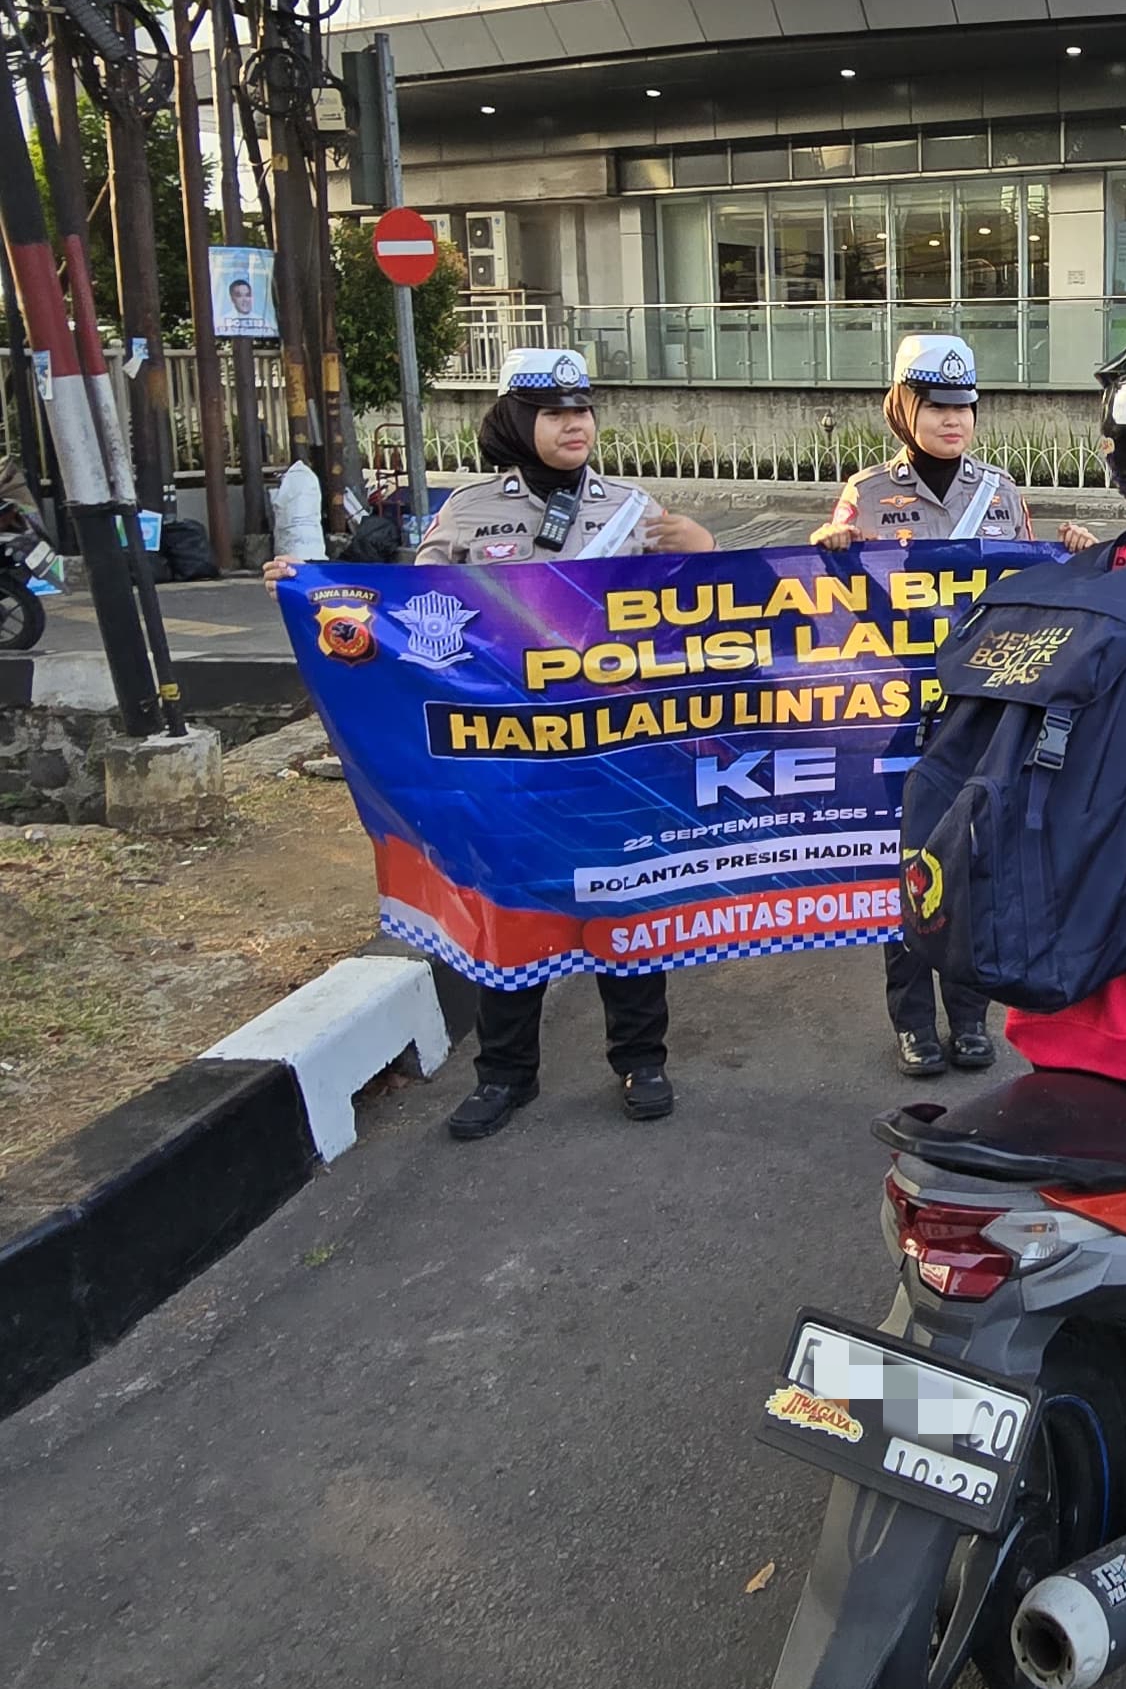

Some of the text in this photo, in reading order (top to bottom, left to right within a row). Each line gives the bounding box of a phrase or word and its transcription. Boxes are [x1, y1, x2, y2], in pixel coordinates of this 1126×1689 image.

[474, 522, 528, 538] MEGA
[313, 588, 375, 602] JAWA BARAT
[606, 574, 868, 632] BULAN
[525, 628, 773, 690] POLISI
[449, 711, 586, 752] HARI
[596, 694, 724, 748] LALU
[743, 679, 911, 724] LINTAS
[695, 747, 837, 806] KE
[623, 834, 655, 852] 22
[659, 811, 806, 843] SEPTEMBER
[812, 807, 868, 822] 1955
[589, 858, 709, 894] POLANTAS
[715, 848, 798, 872] PRESISI
[804, 842, 872, 860] HADIR
[674, 899, 794, 943] LANTAS
